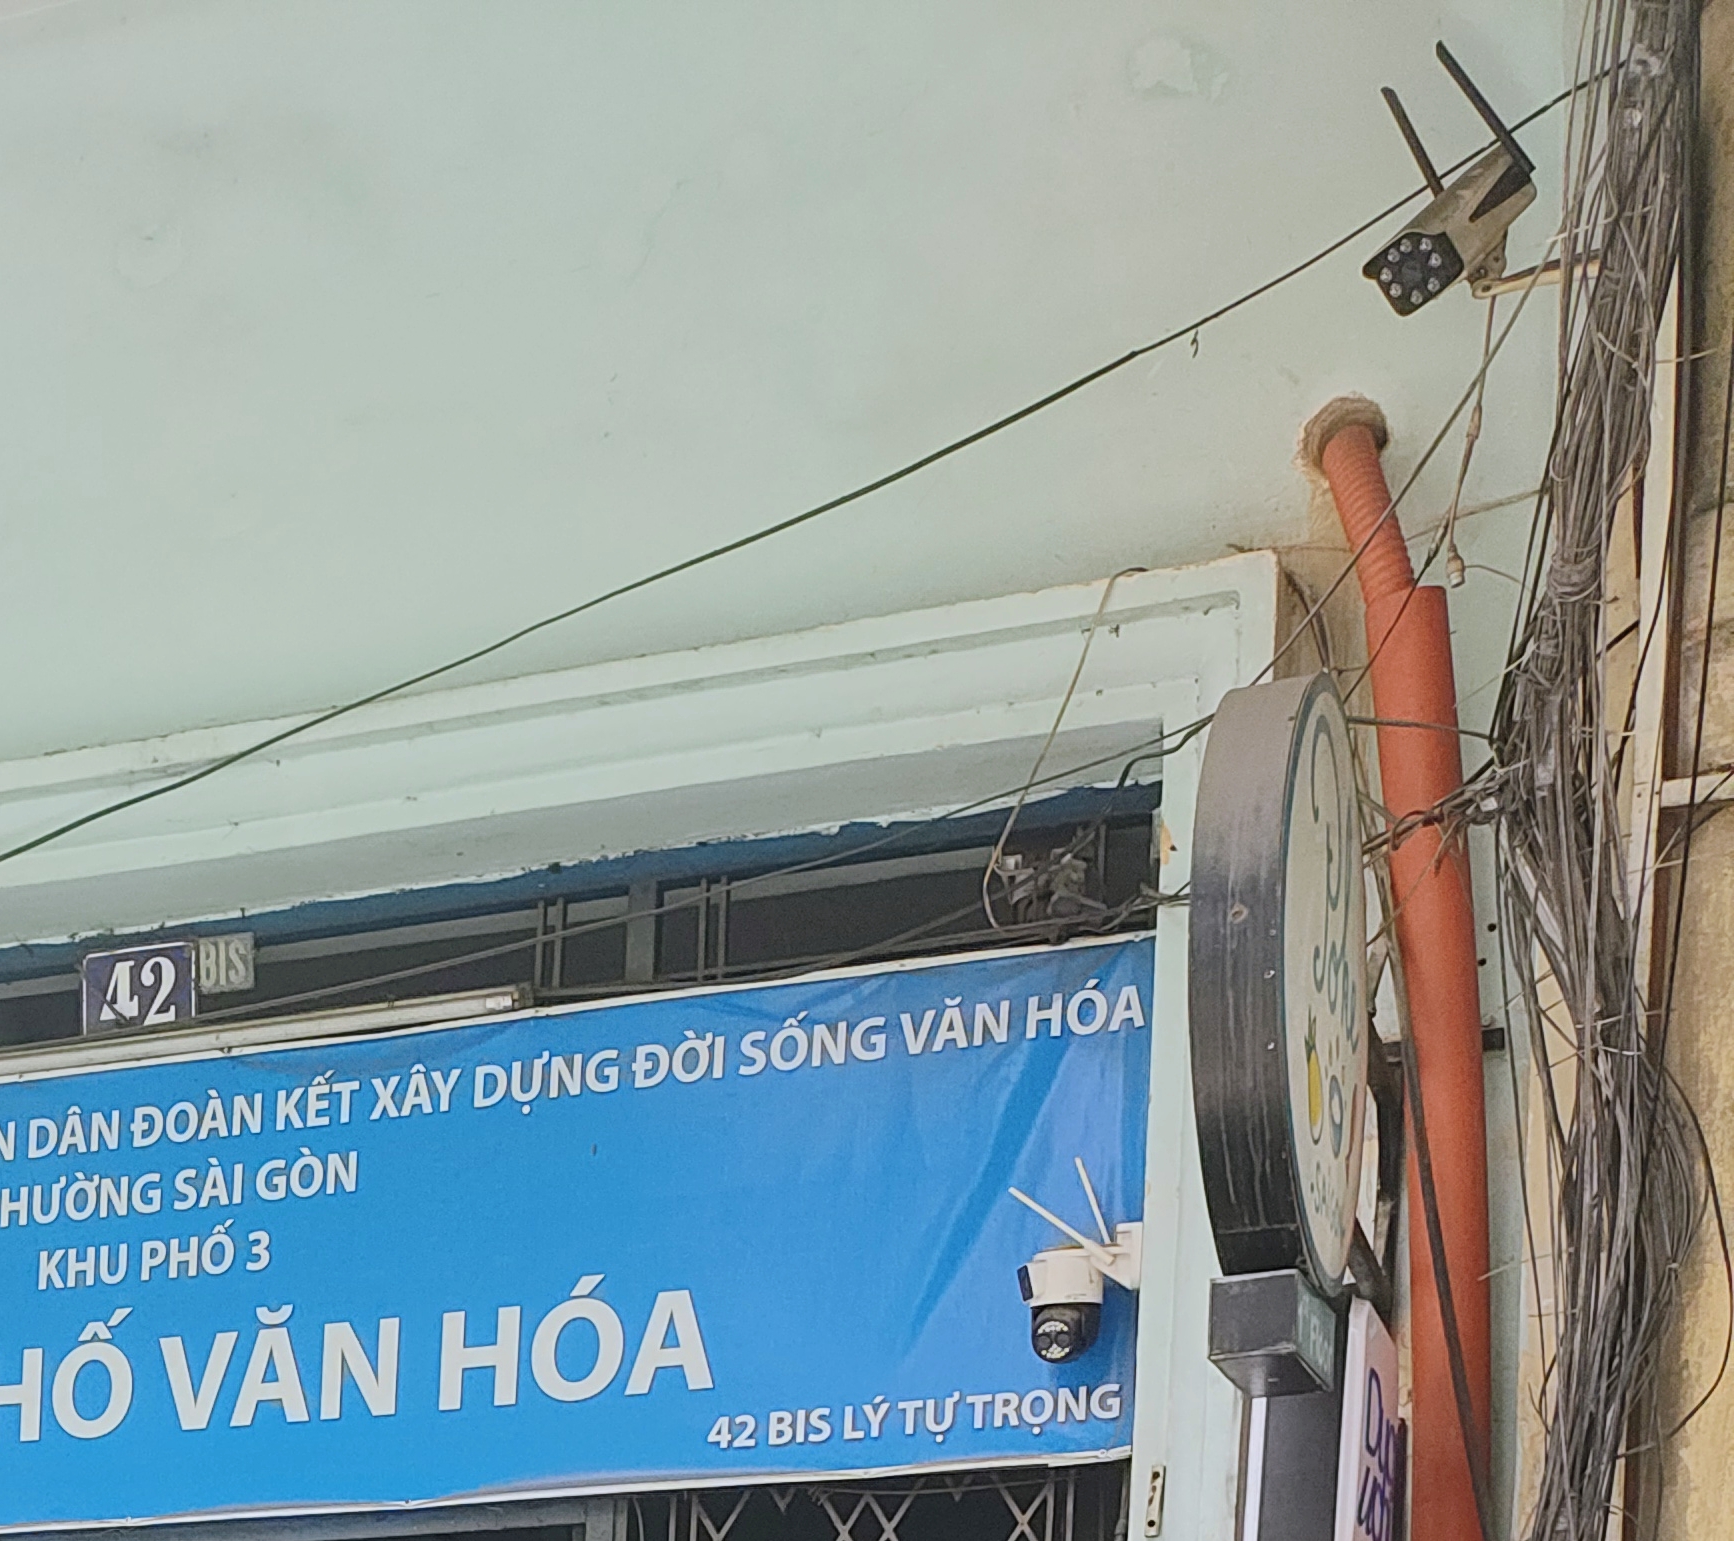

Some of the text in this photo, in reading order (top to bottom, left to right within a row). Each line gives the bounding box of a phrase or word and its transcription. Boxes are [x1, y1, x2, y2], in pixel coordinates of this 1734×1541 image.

[100, 939, 247, 1026] 42 BIS
[27, 1107, 121, 1161] DÂN
[130, 1090, 263, 1146] ĐOÀN
[275, 1072, 361, 1132] KẾT
[368, 1063, 458, 1121] XÂY
[472, 1046, 619, 1118] DỰNG
[631, 1031, 727, 1093] ĐỜI
[738, 1010, 888, 1078] SỐNG
[899, 995, 1010, 1056] VĂN
[1025, 976, 1146, 1040] HÓA
[173, 1158, 243, 1211] SÀI
[265, 1147, 360, 1201] GÒN
[37, 1221, 273, 1292] KHU PHỐ 3
[159, 1303, 402, 1432] VĂN
[436, 1273, 715, 1413] HÓA
[705, 1381, 1123, 1452] 42 BIS LÝ TỰ TRỌNG
